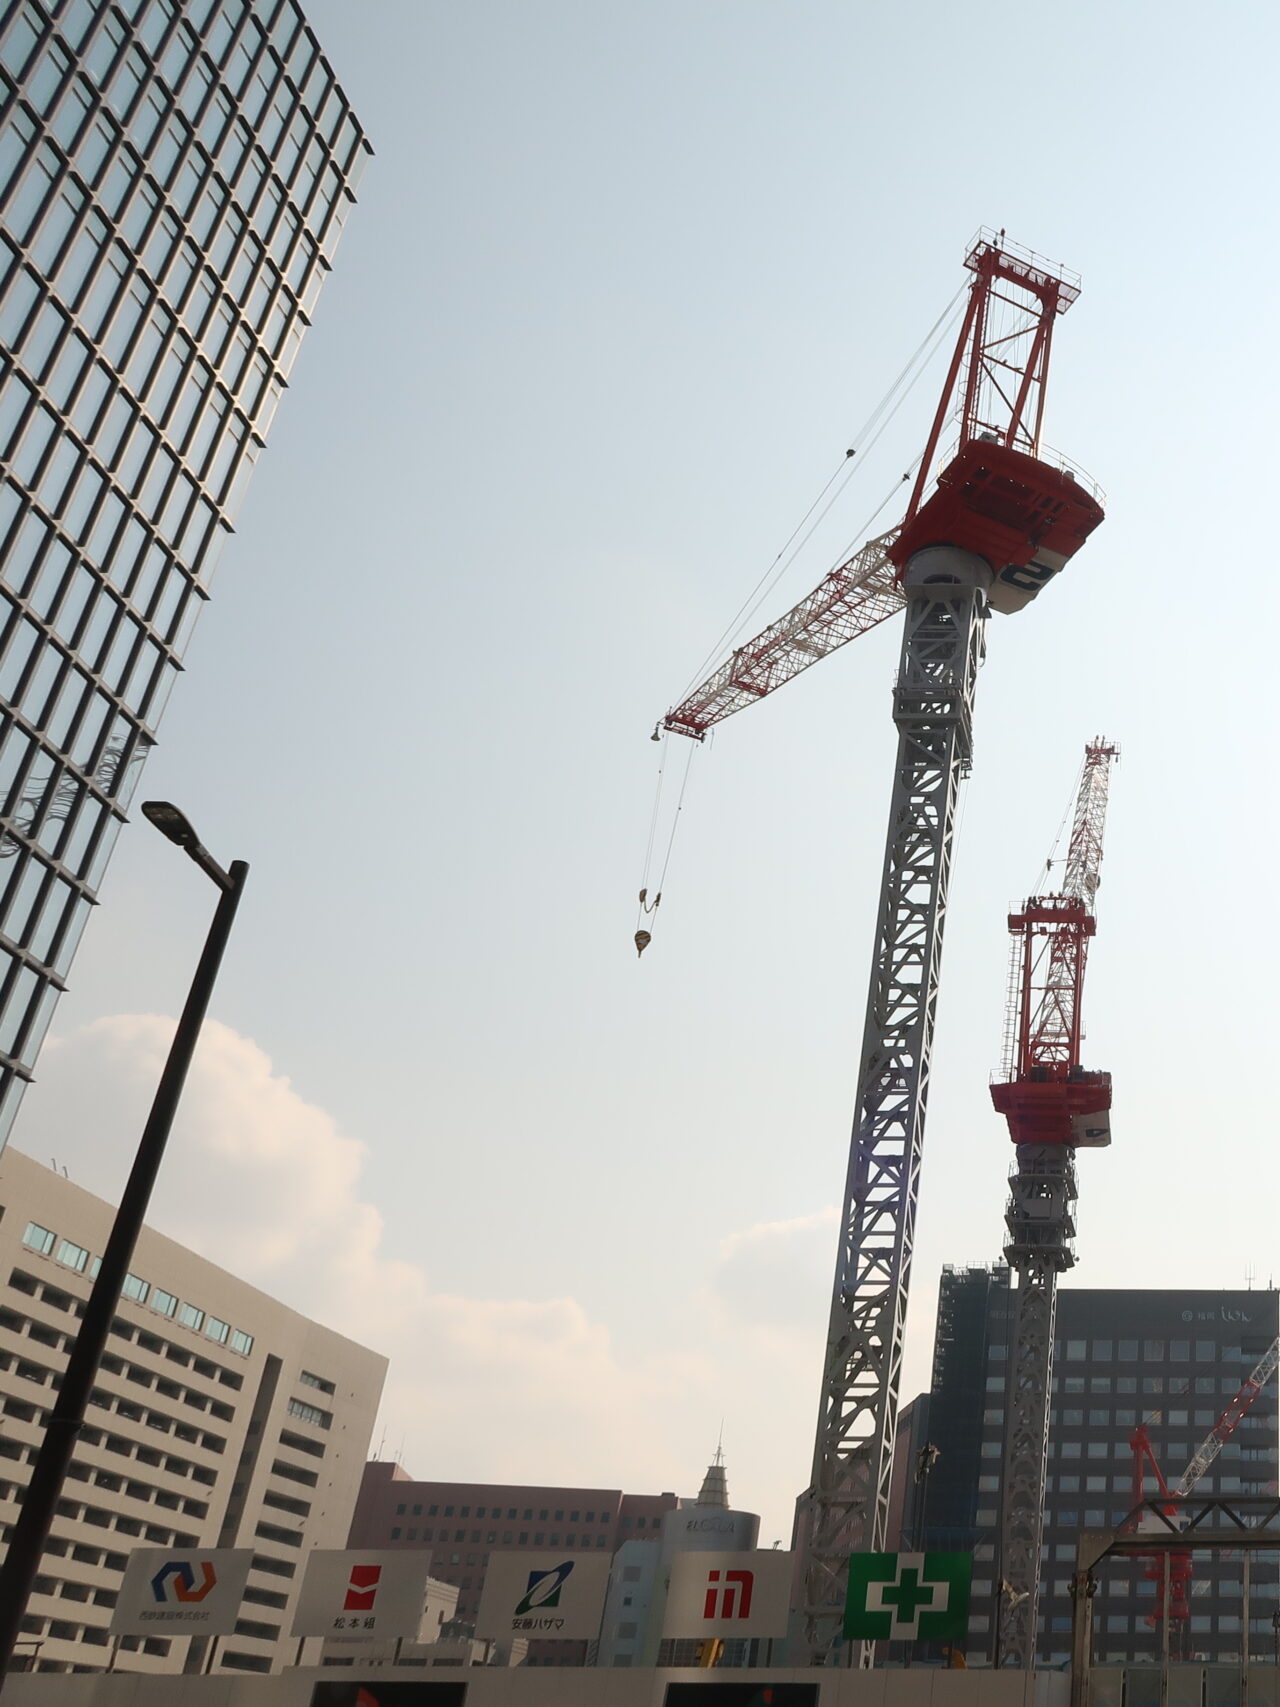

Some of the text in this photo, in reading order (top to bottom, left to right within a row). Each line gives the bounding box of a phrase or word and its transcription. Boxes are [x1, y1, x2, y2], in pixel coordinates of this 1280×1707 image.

[333, 1616, 376, 1630] 松本組
[512, 1617, 565, 1631] 安藤ハザマ
